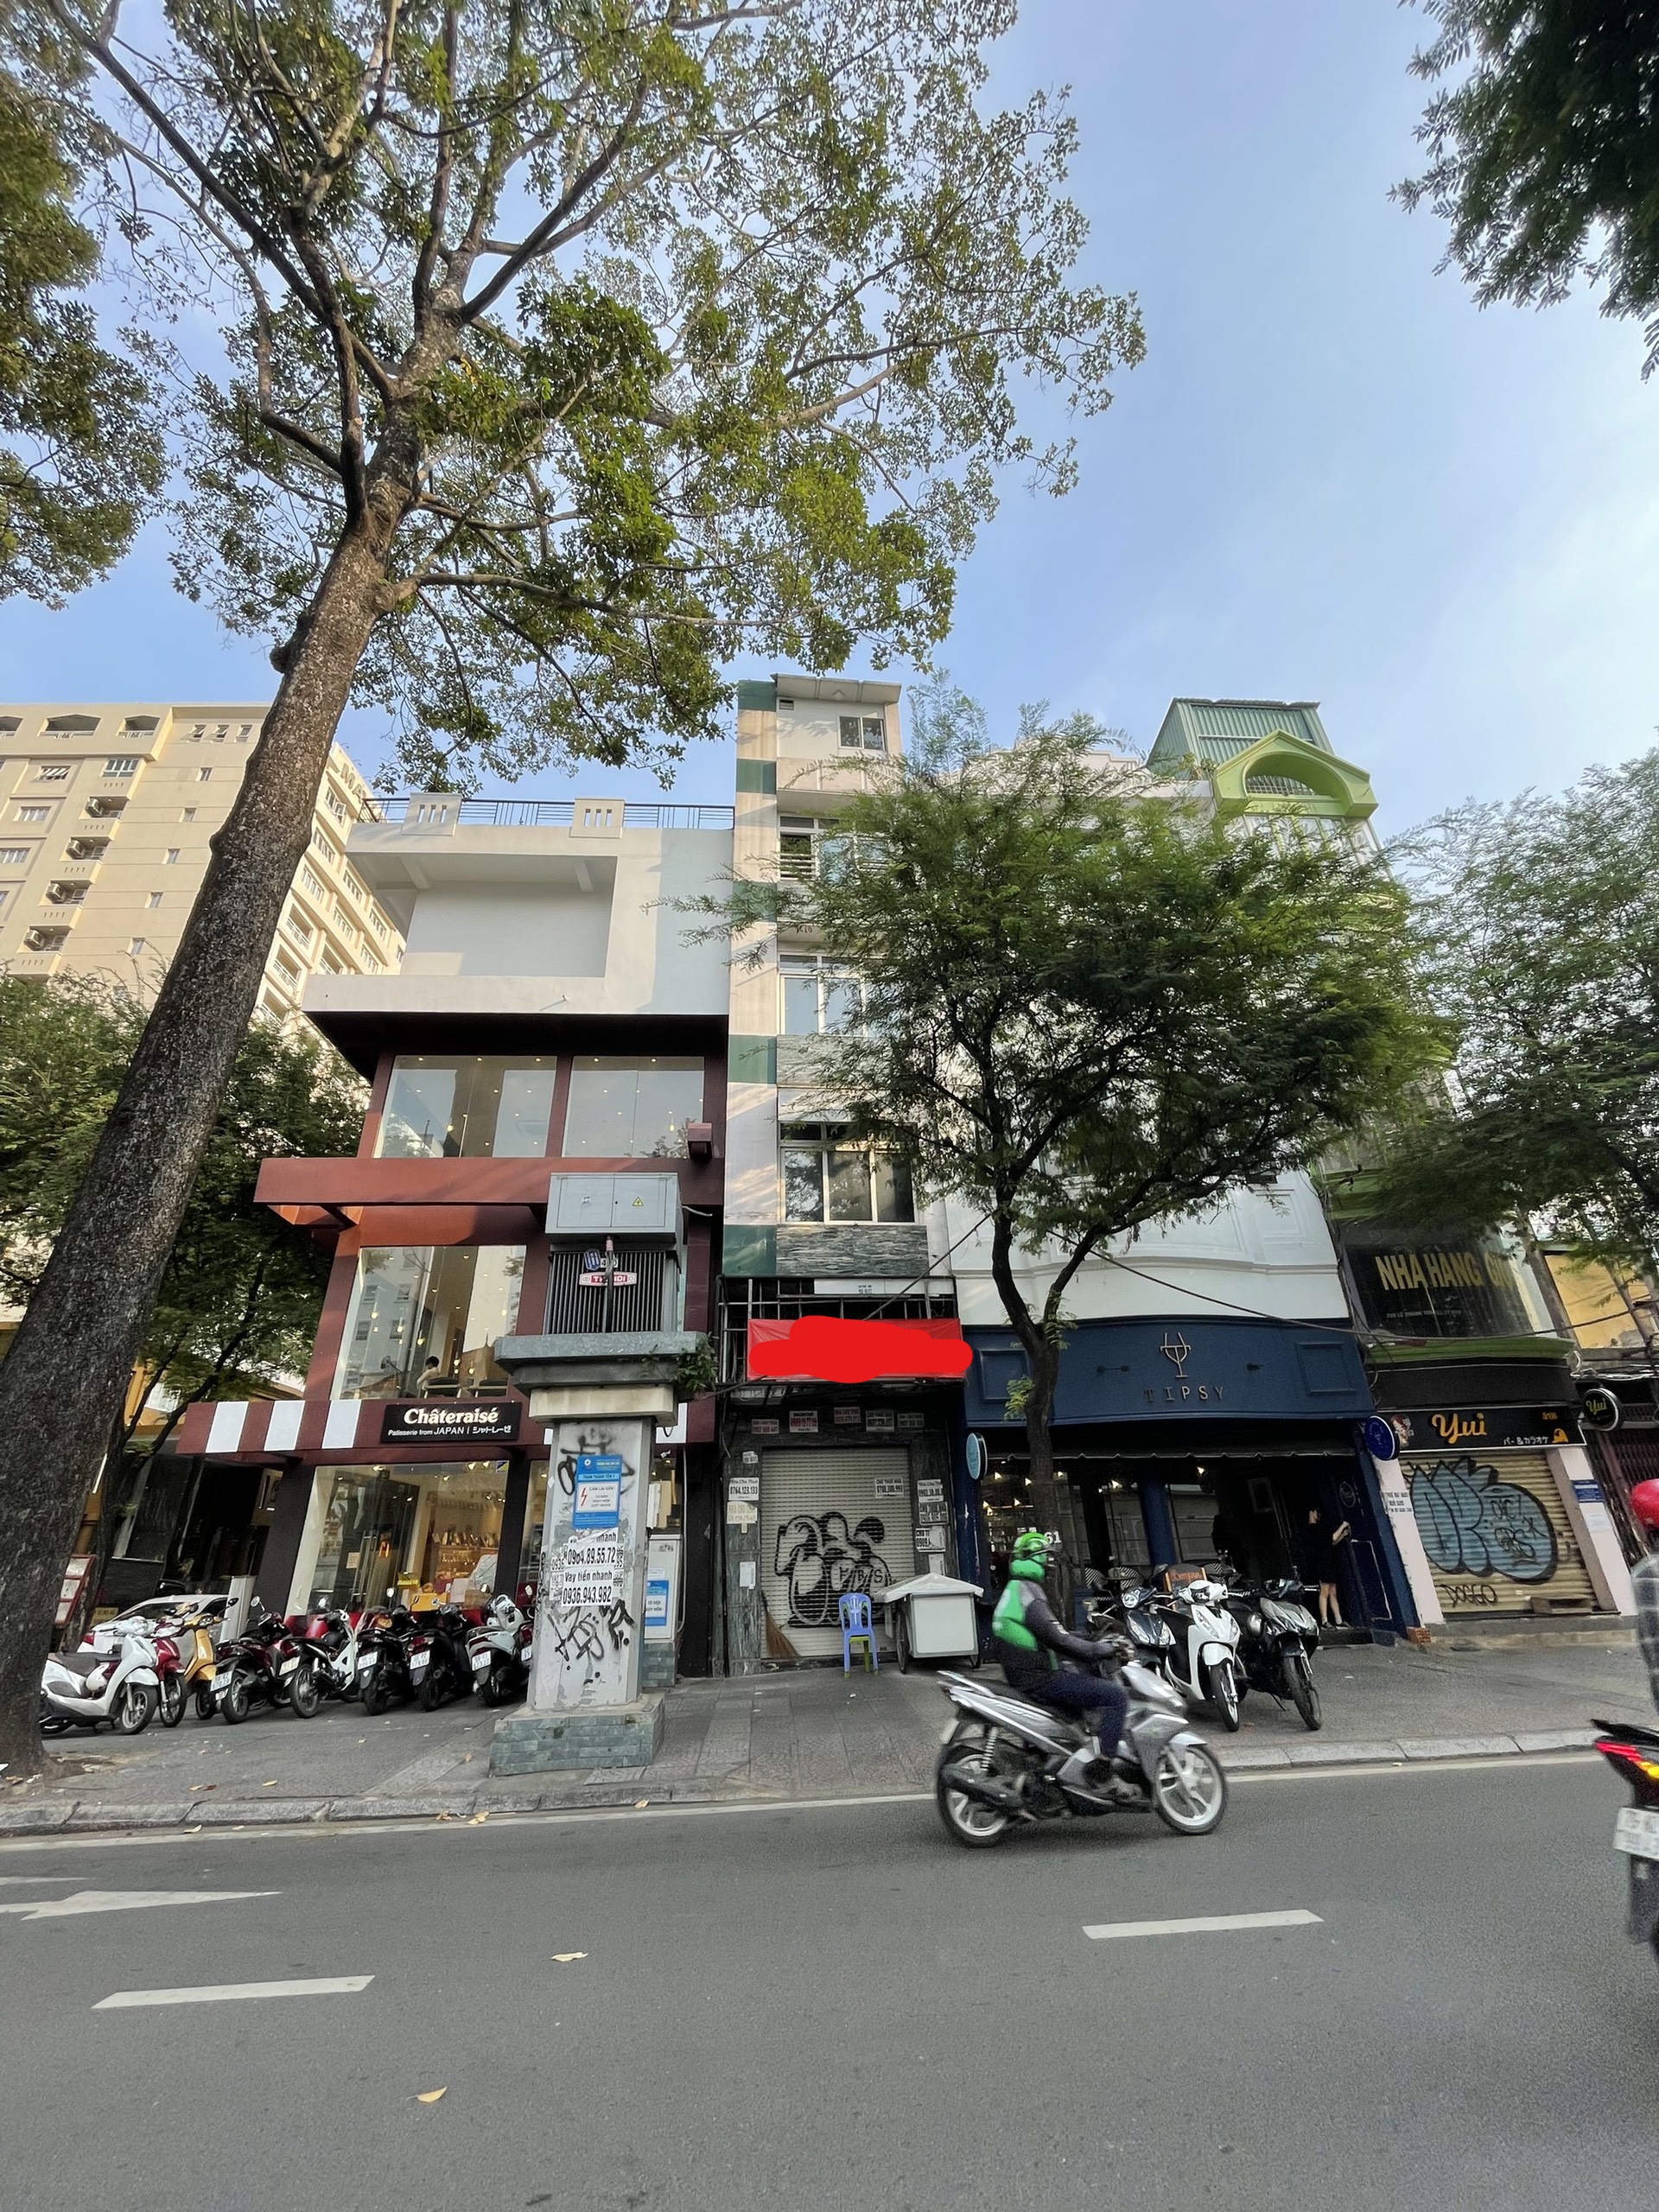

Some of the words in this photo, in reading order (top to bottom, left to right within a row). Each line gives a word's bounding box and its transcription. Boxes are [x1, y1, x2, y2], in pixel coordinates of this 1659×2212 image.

[1143, 1385, 1224, 1402] TIPSY
[1586, 1397, 1607, 1415] Yui
[404, 1407, 499, 1424] Châteraisé
[1432, 1413, 1487, 1444] Yui
[564, 1573, 576, 1583] Vay
[577, 1569, 591, 1582] tiền
[592, 1571, 613, 1581] nhanh
[563, 1586, 613, 1605] 0936.943.982
